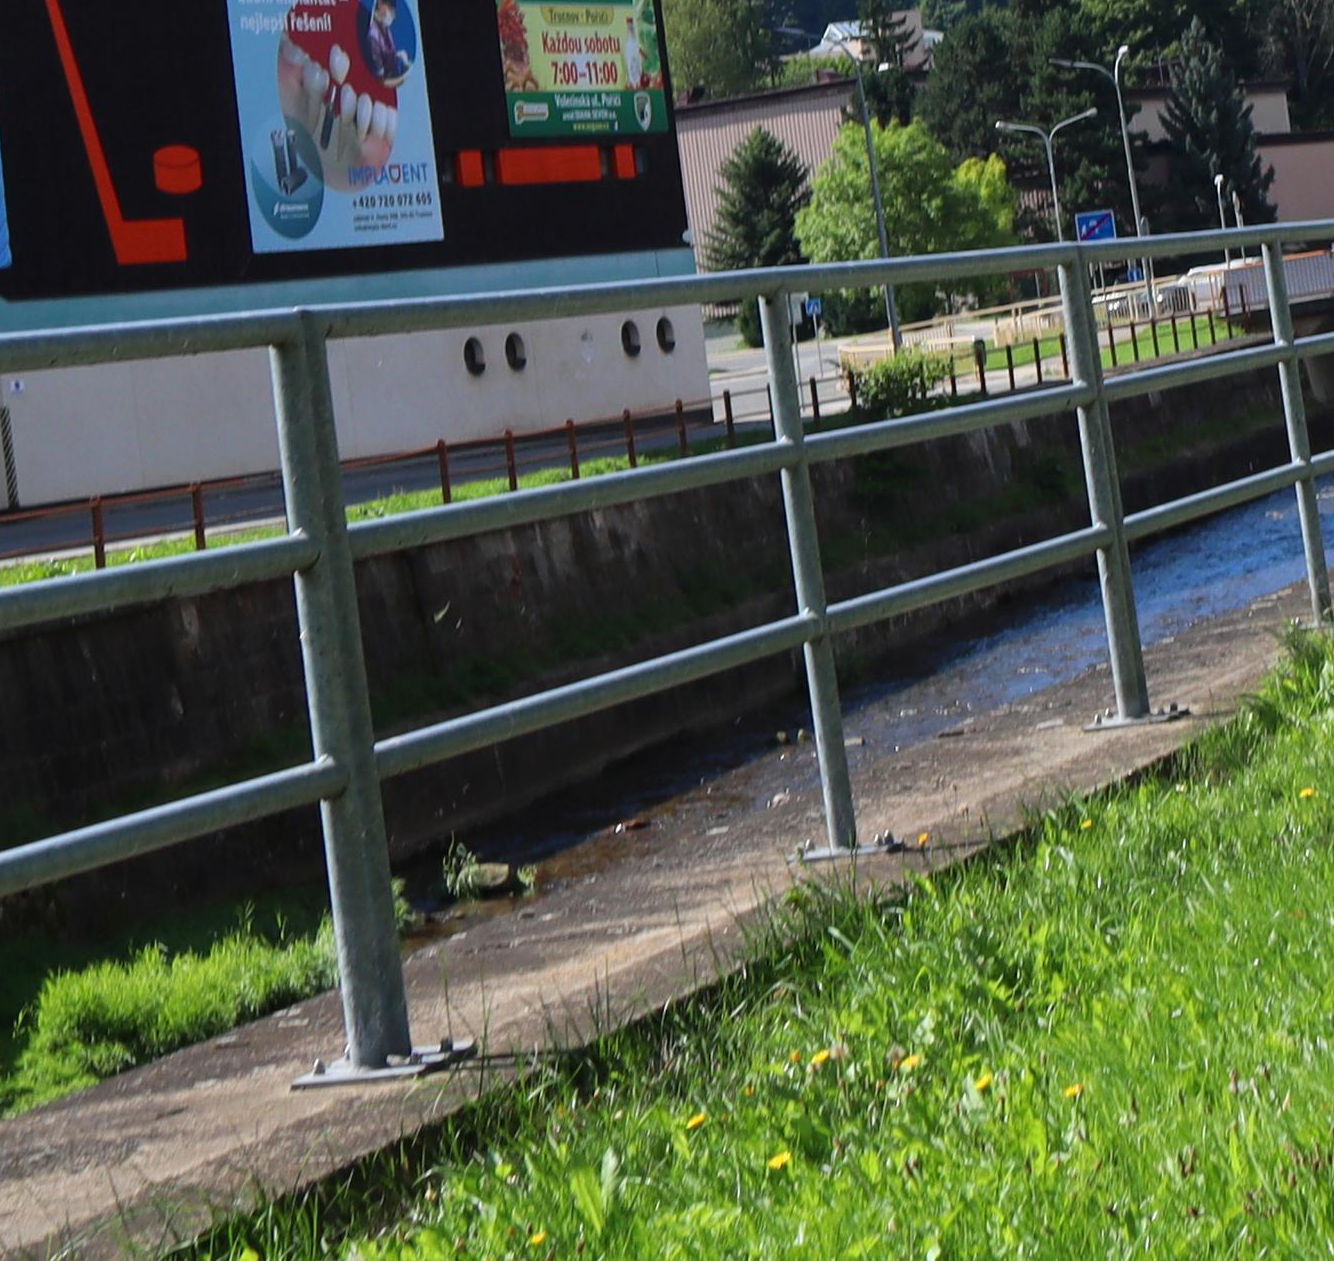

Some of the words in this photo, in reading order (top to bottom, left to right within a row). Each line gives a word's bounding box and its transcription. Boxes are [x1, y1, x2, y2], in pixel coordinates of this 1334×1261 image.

[240, 12, 287, 35] nejlepší
[289, 11, 332, 32] řešení!
[541, 30, 582, 54] Každou
[584, 30, 620, 54] sobotu
[348, 162, 427, 187] IMPLADENT
